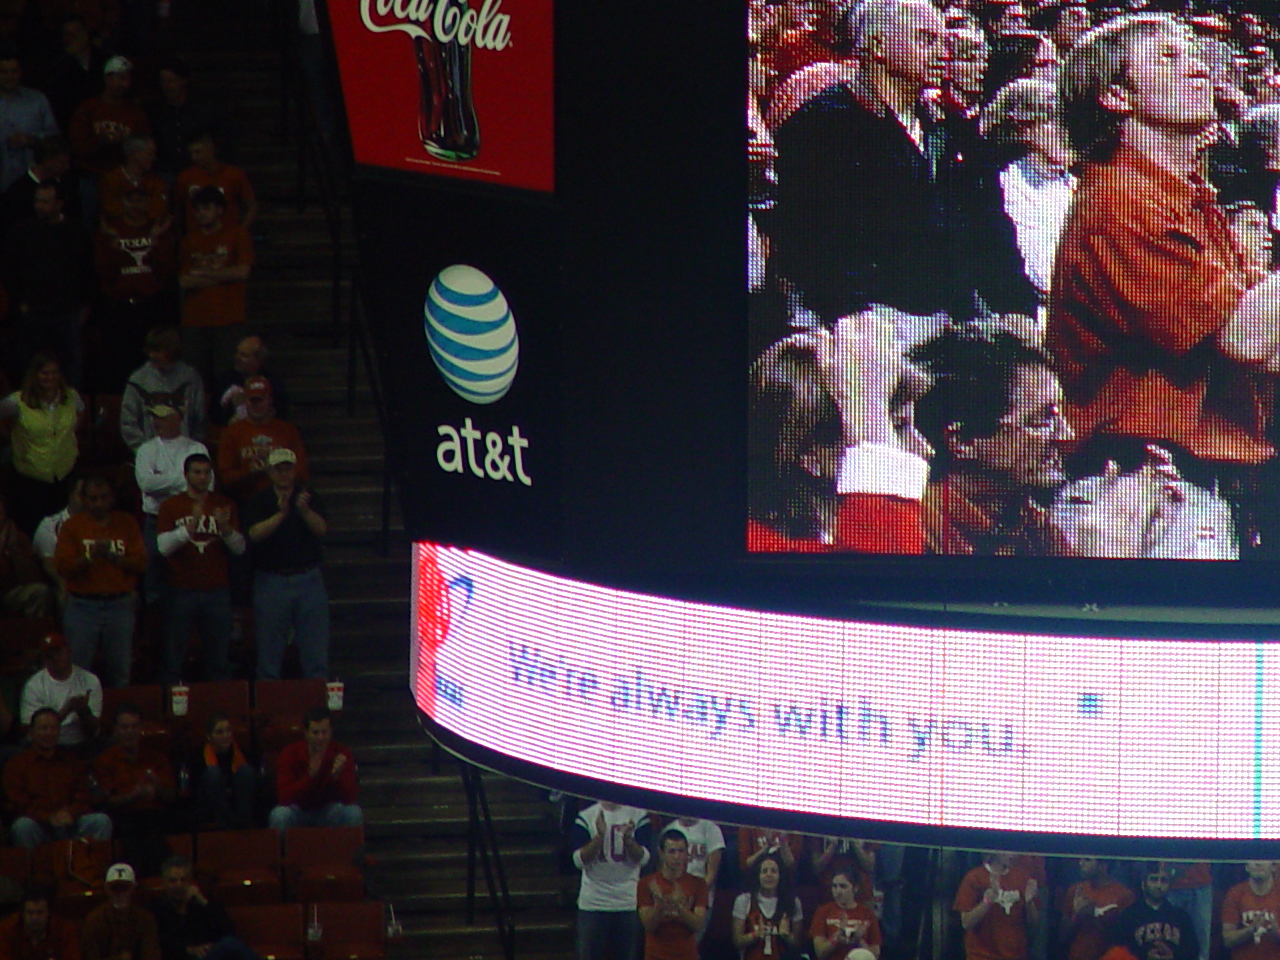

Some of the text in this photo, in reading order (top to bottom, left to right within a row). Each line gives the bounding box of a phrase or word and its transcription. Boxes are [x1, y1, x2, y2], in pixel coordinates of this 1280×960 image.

[437, 418, 532, 486] at&t
[82, 539, 125, 561] TAS
[509, 641, 598, 703] We're
[611, 664, 756, 741] always
[774, 694, 893, 748] with
